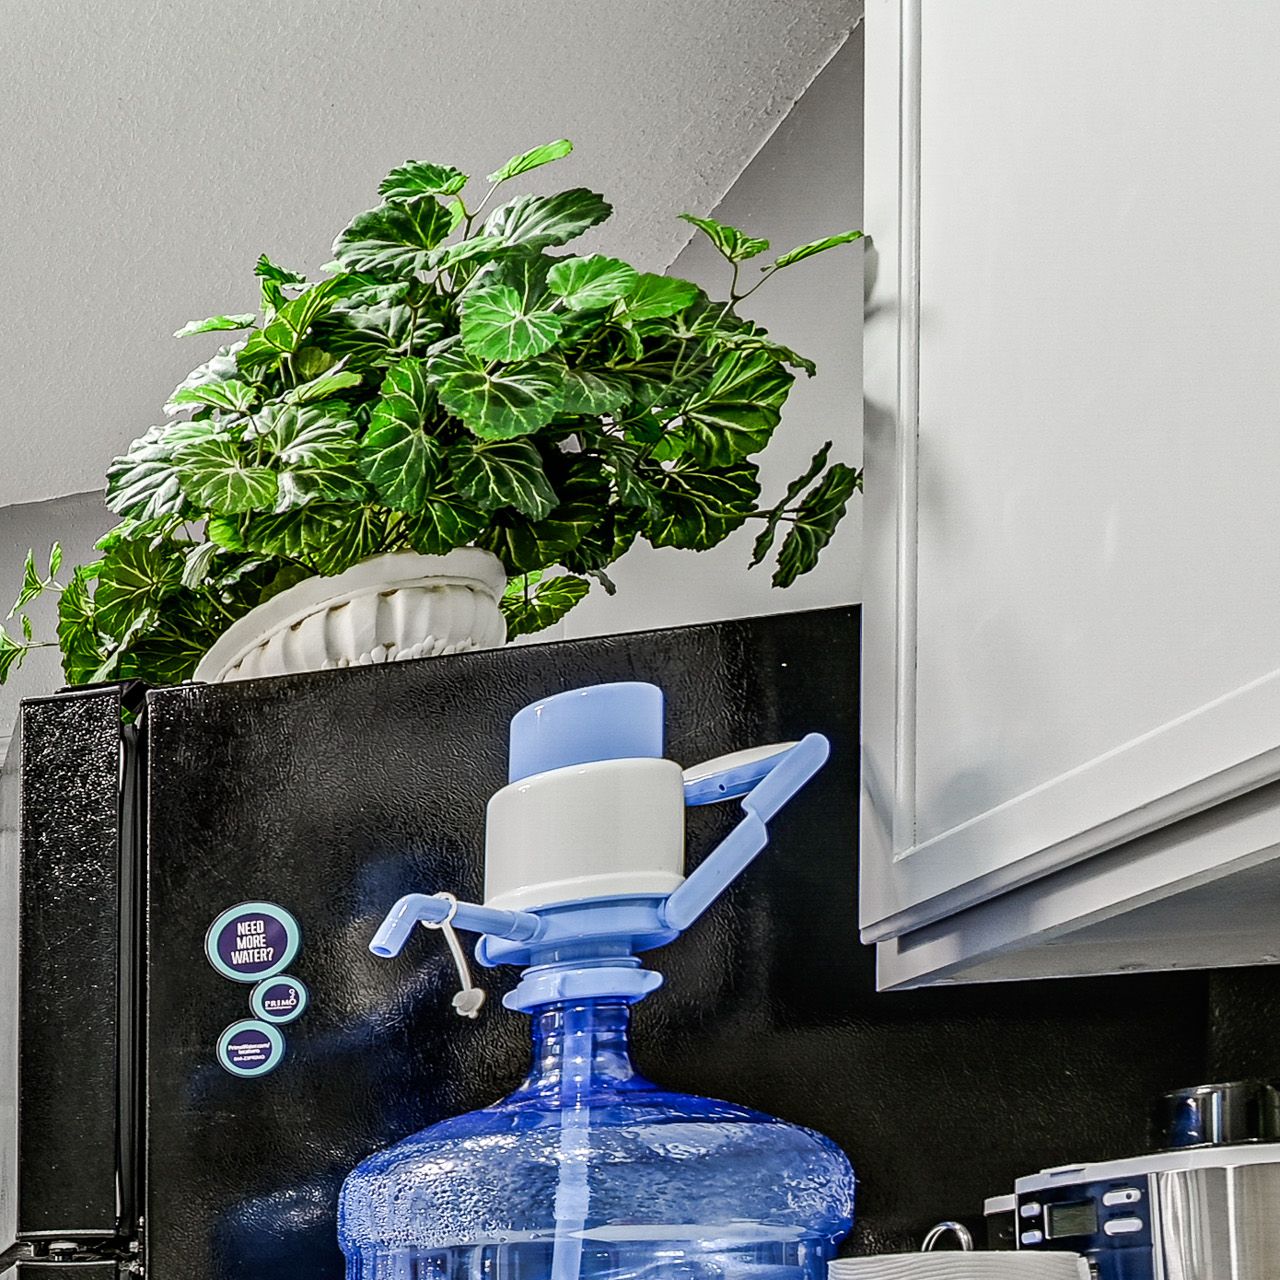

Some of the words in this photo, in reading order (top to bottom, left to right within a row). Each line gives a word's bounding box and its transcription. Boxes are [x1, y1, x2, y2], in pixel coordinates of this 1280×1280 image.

[237, 920, 264, 935] NEED
[236, 934, 267, 950] MORE
[231, 947, 274, 965] WATER?
[265, 998, 297, 1007] PRIMO
